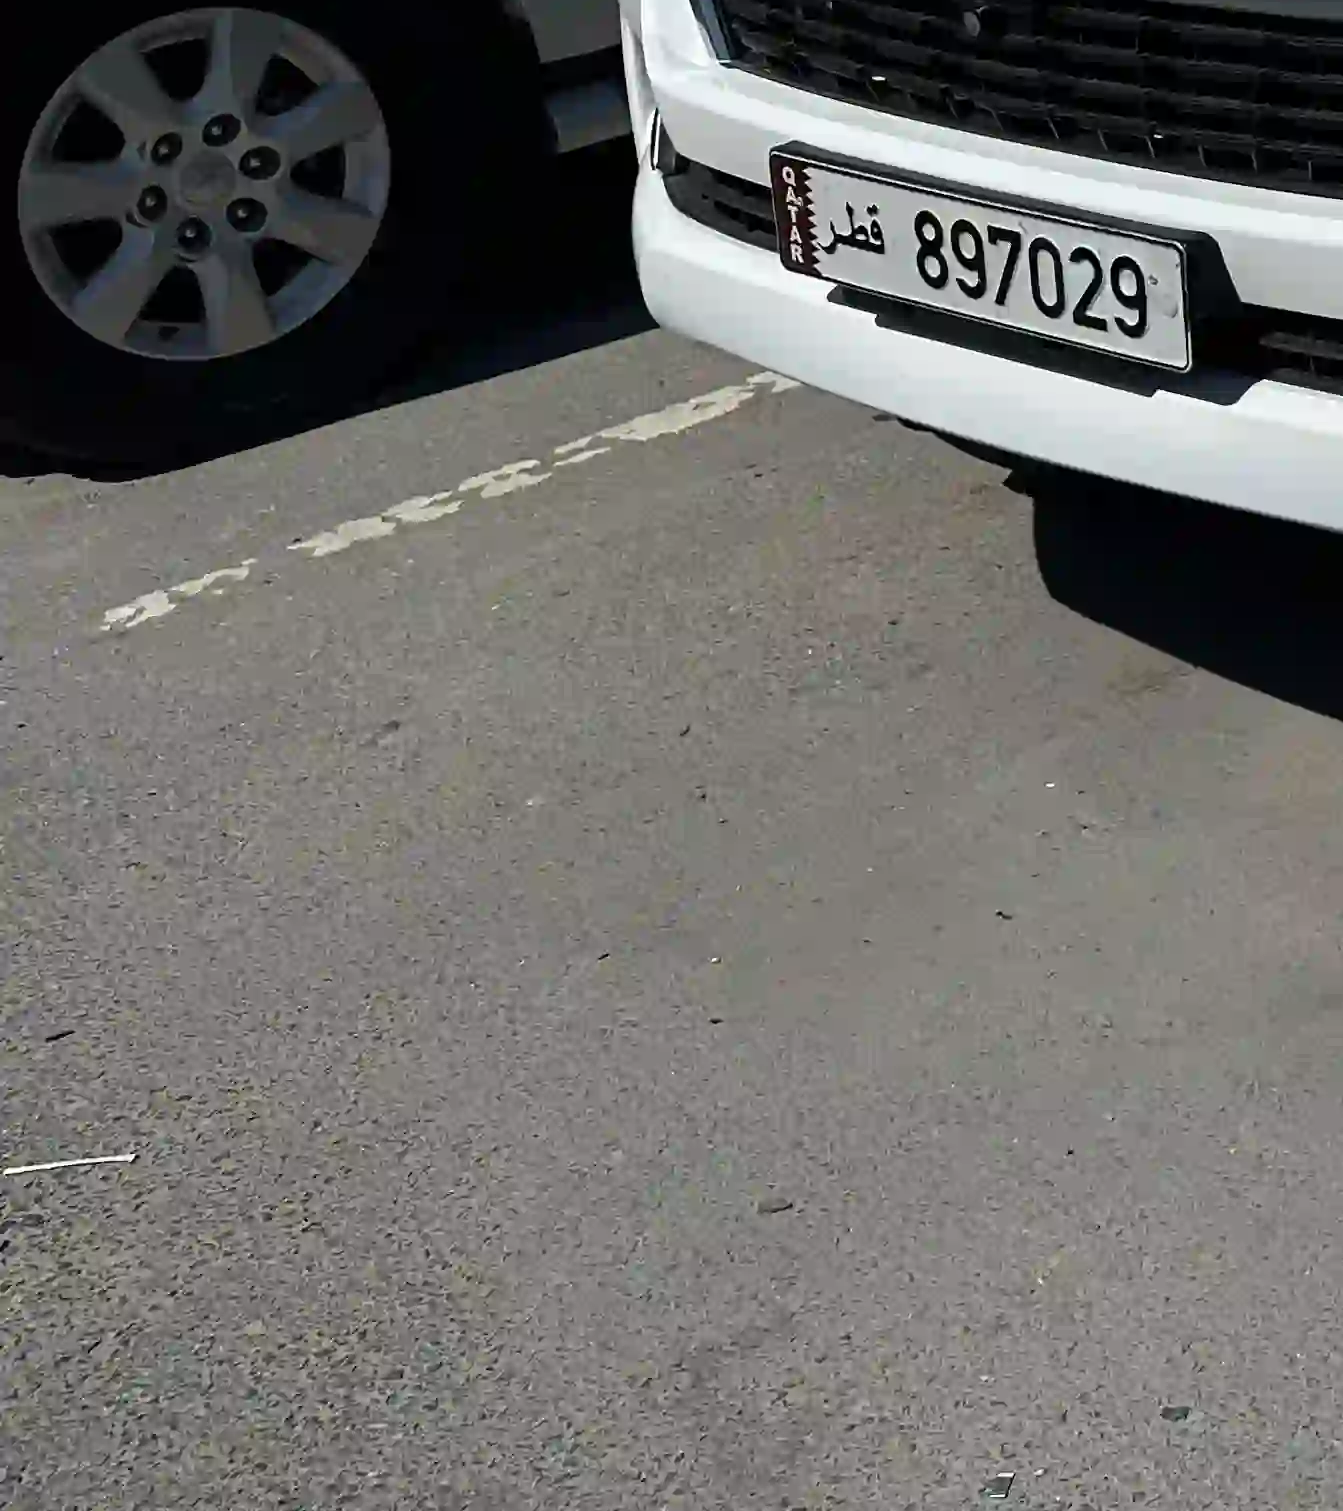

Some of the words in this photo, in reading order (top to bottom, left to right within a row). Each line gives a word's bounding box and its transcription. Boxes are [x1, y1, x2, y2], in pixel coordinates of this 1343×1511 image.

[781, 165, 804, 265] QATAR
[817, 201, 886, 254] قطر
[913, 209, 1149, 339] 897029
